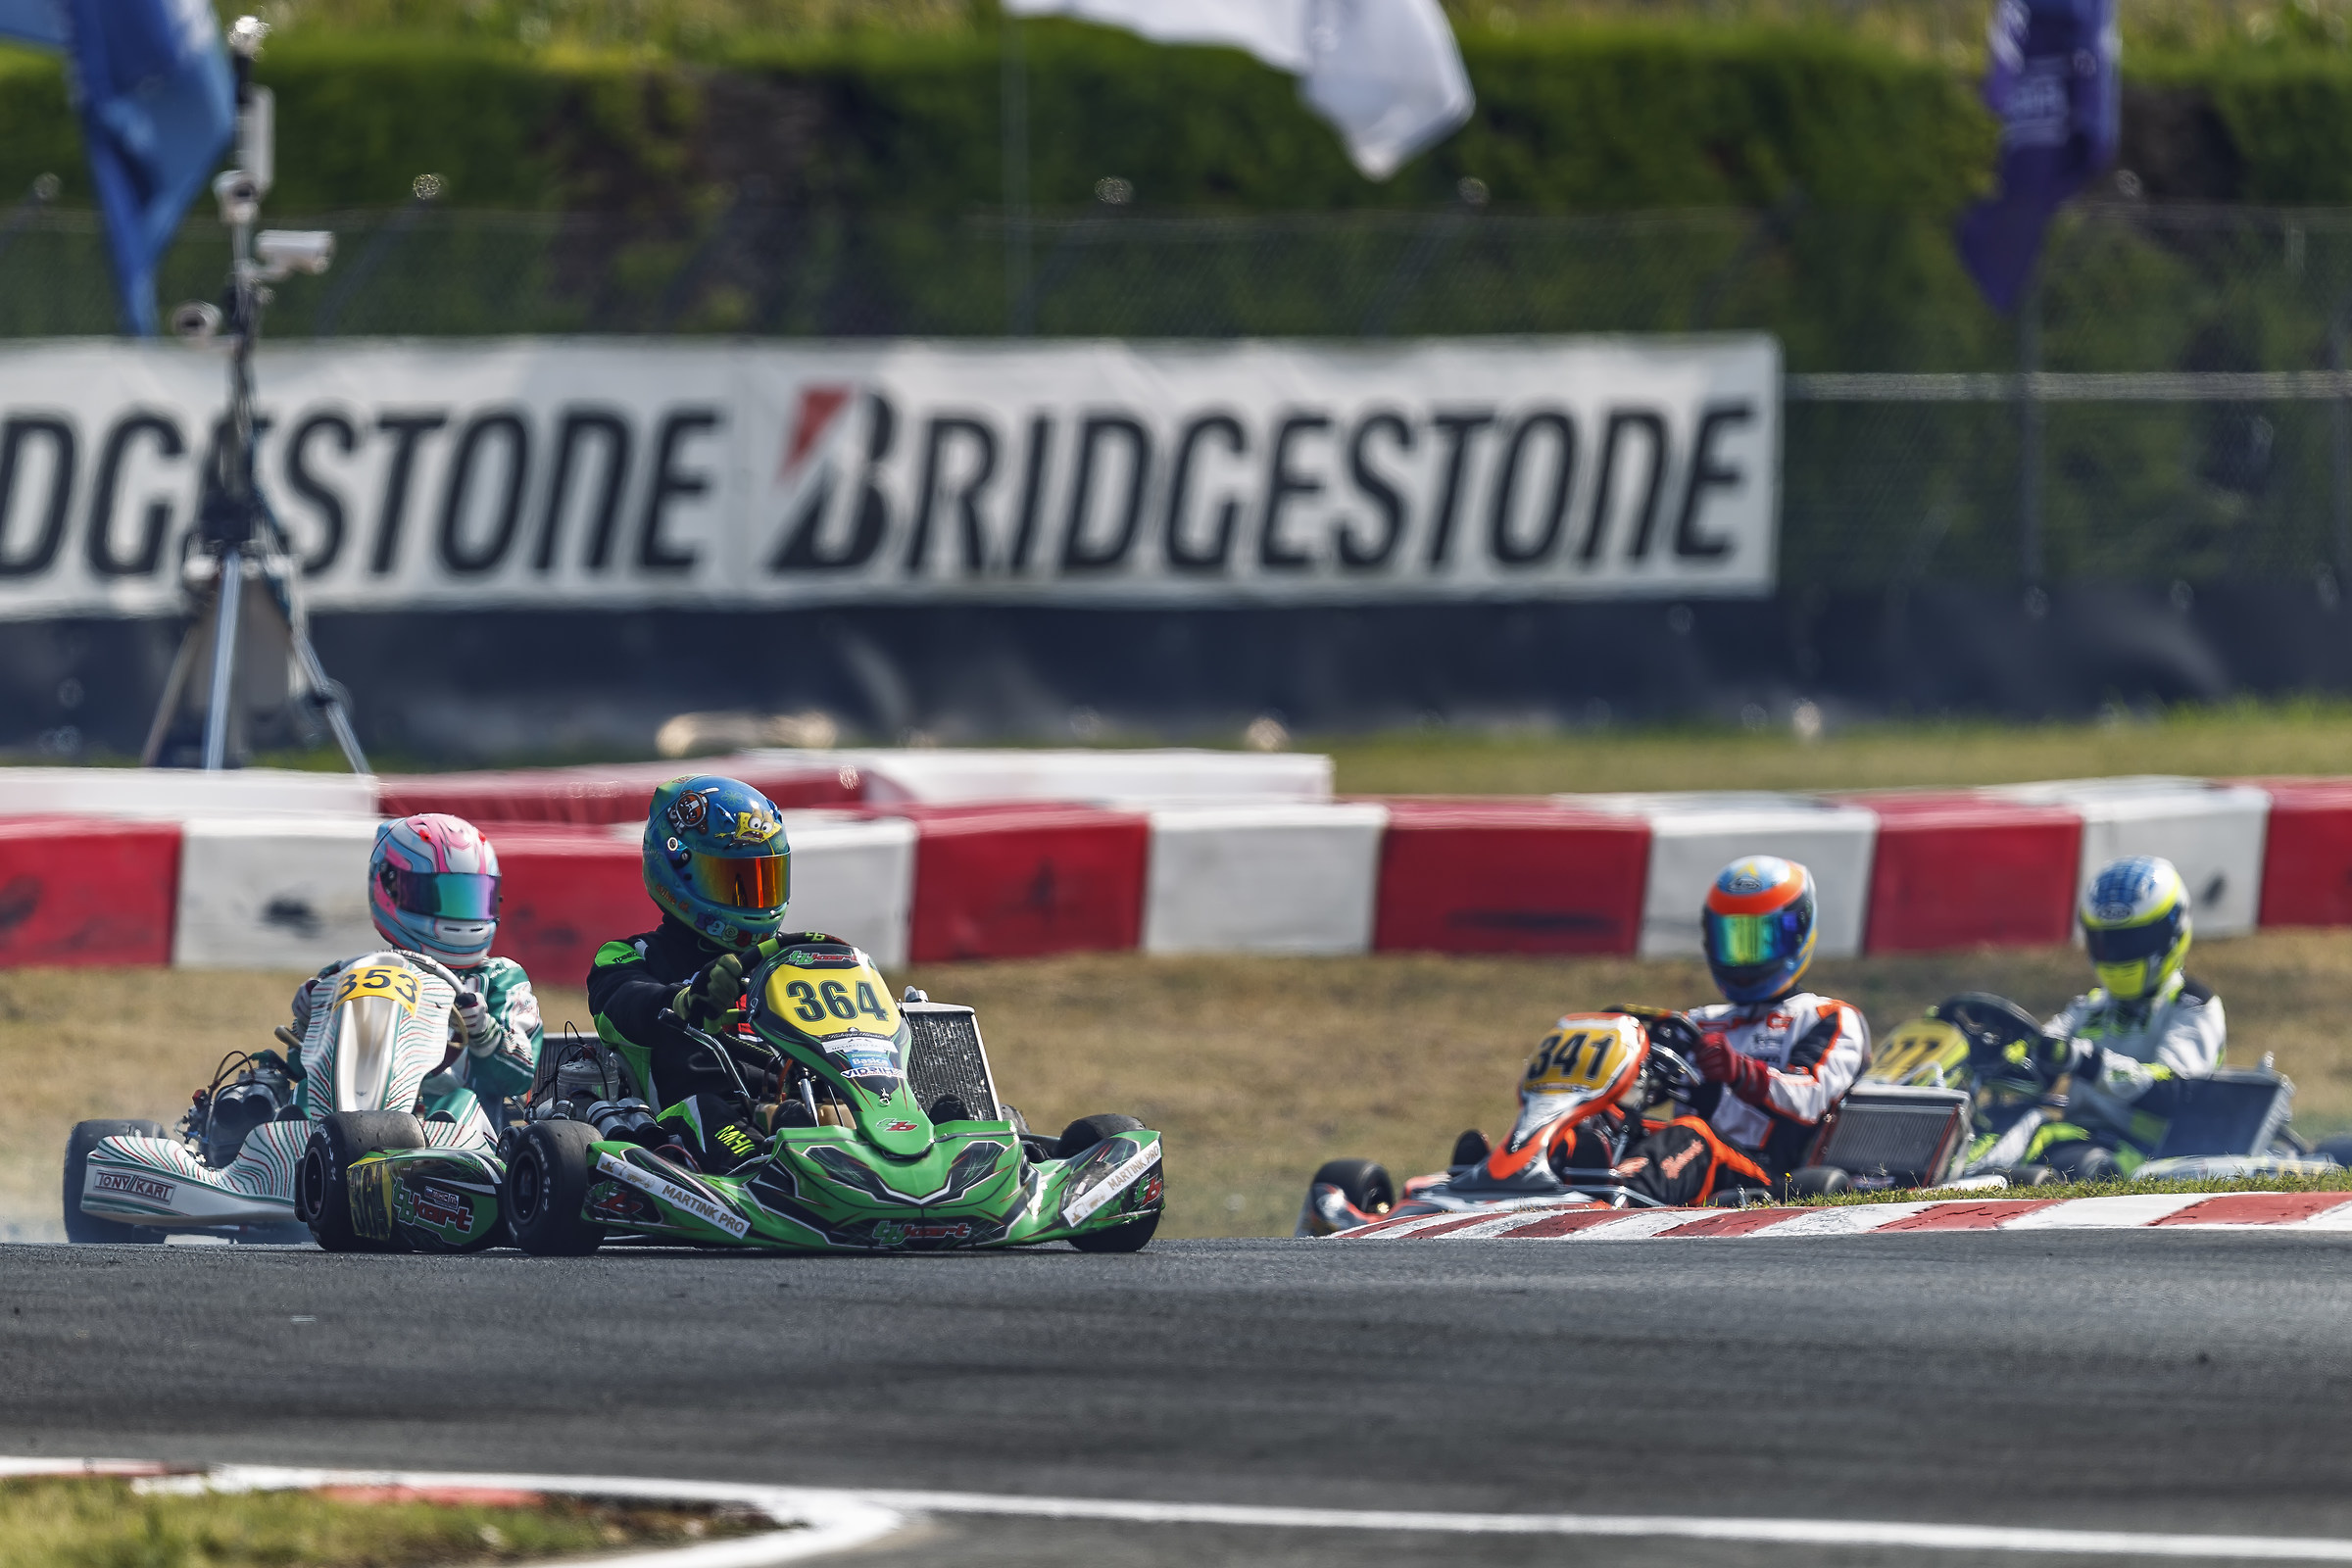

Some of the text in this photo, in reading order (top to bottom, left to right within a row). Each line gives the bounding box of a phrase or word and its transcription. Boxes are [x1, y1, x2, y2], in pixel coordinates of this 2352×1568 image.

[0, 404, 725, 578] DGSTONE
[770, 386, 1754, 574] BRIDGESTONE
[335, 969, 418, 1004] 353
[786, 979, 889, 1022] 364
[1528, 1032, 1615, 1081] 341
[96, 1171, 173, 1200] TONY KART
[1106, 1145, 1159, 1191] MARTINK PRO
[662, 1184, 746, 1234] MARTINK PRO
